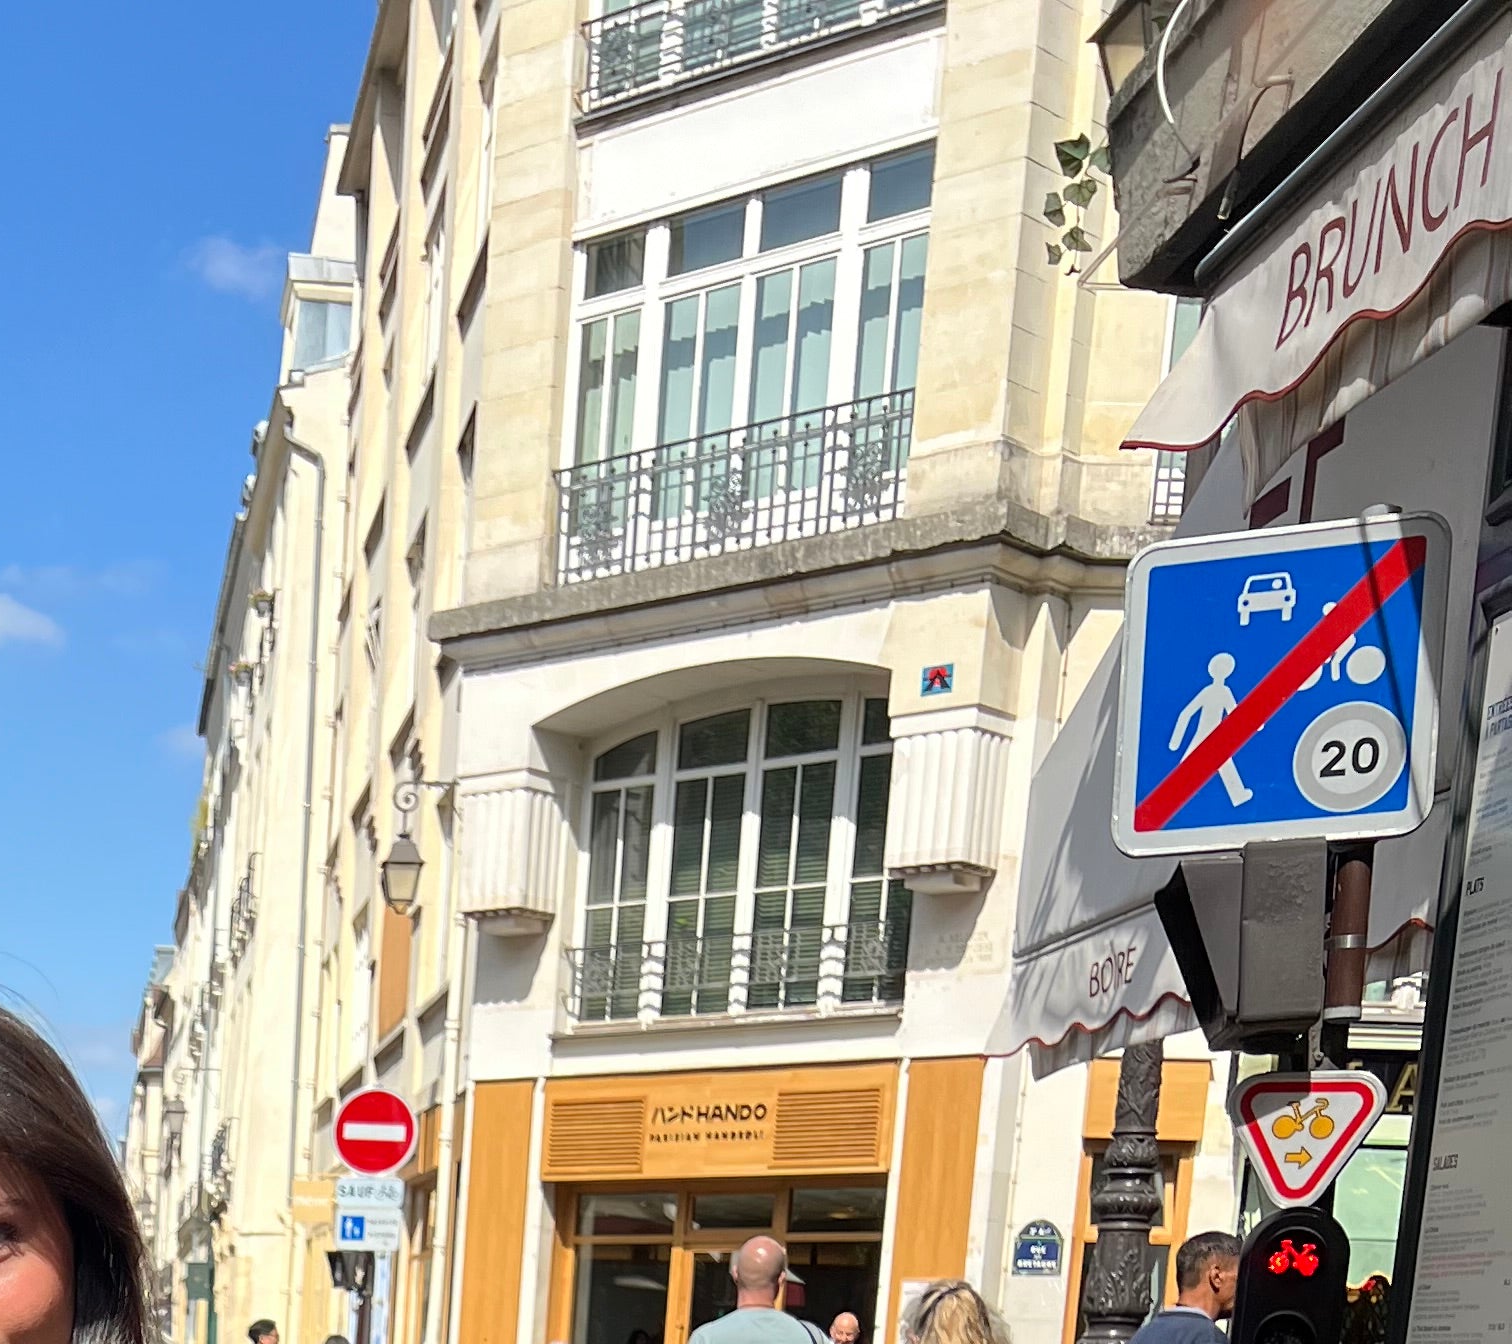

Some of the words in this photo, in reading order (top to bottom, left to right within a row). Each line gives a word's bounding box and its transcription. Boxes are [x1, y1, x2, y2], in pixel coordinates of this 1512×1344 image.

[1274, 66, 1504, 352] BRUNCH
[1319, 737, 1381, 779] 20
[696, 1103, 767, 1122] HANDO
[338, 1184, 374, 1199] SAUF
